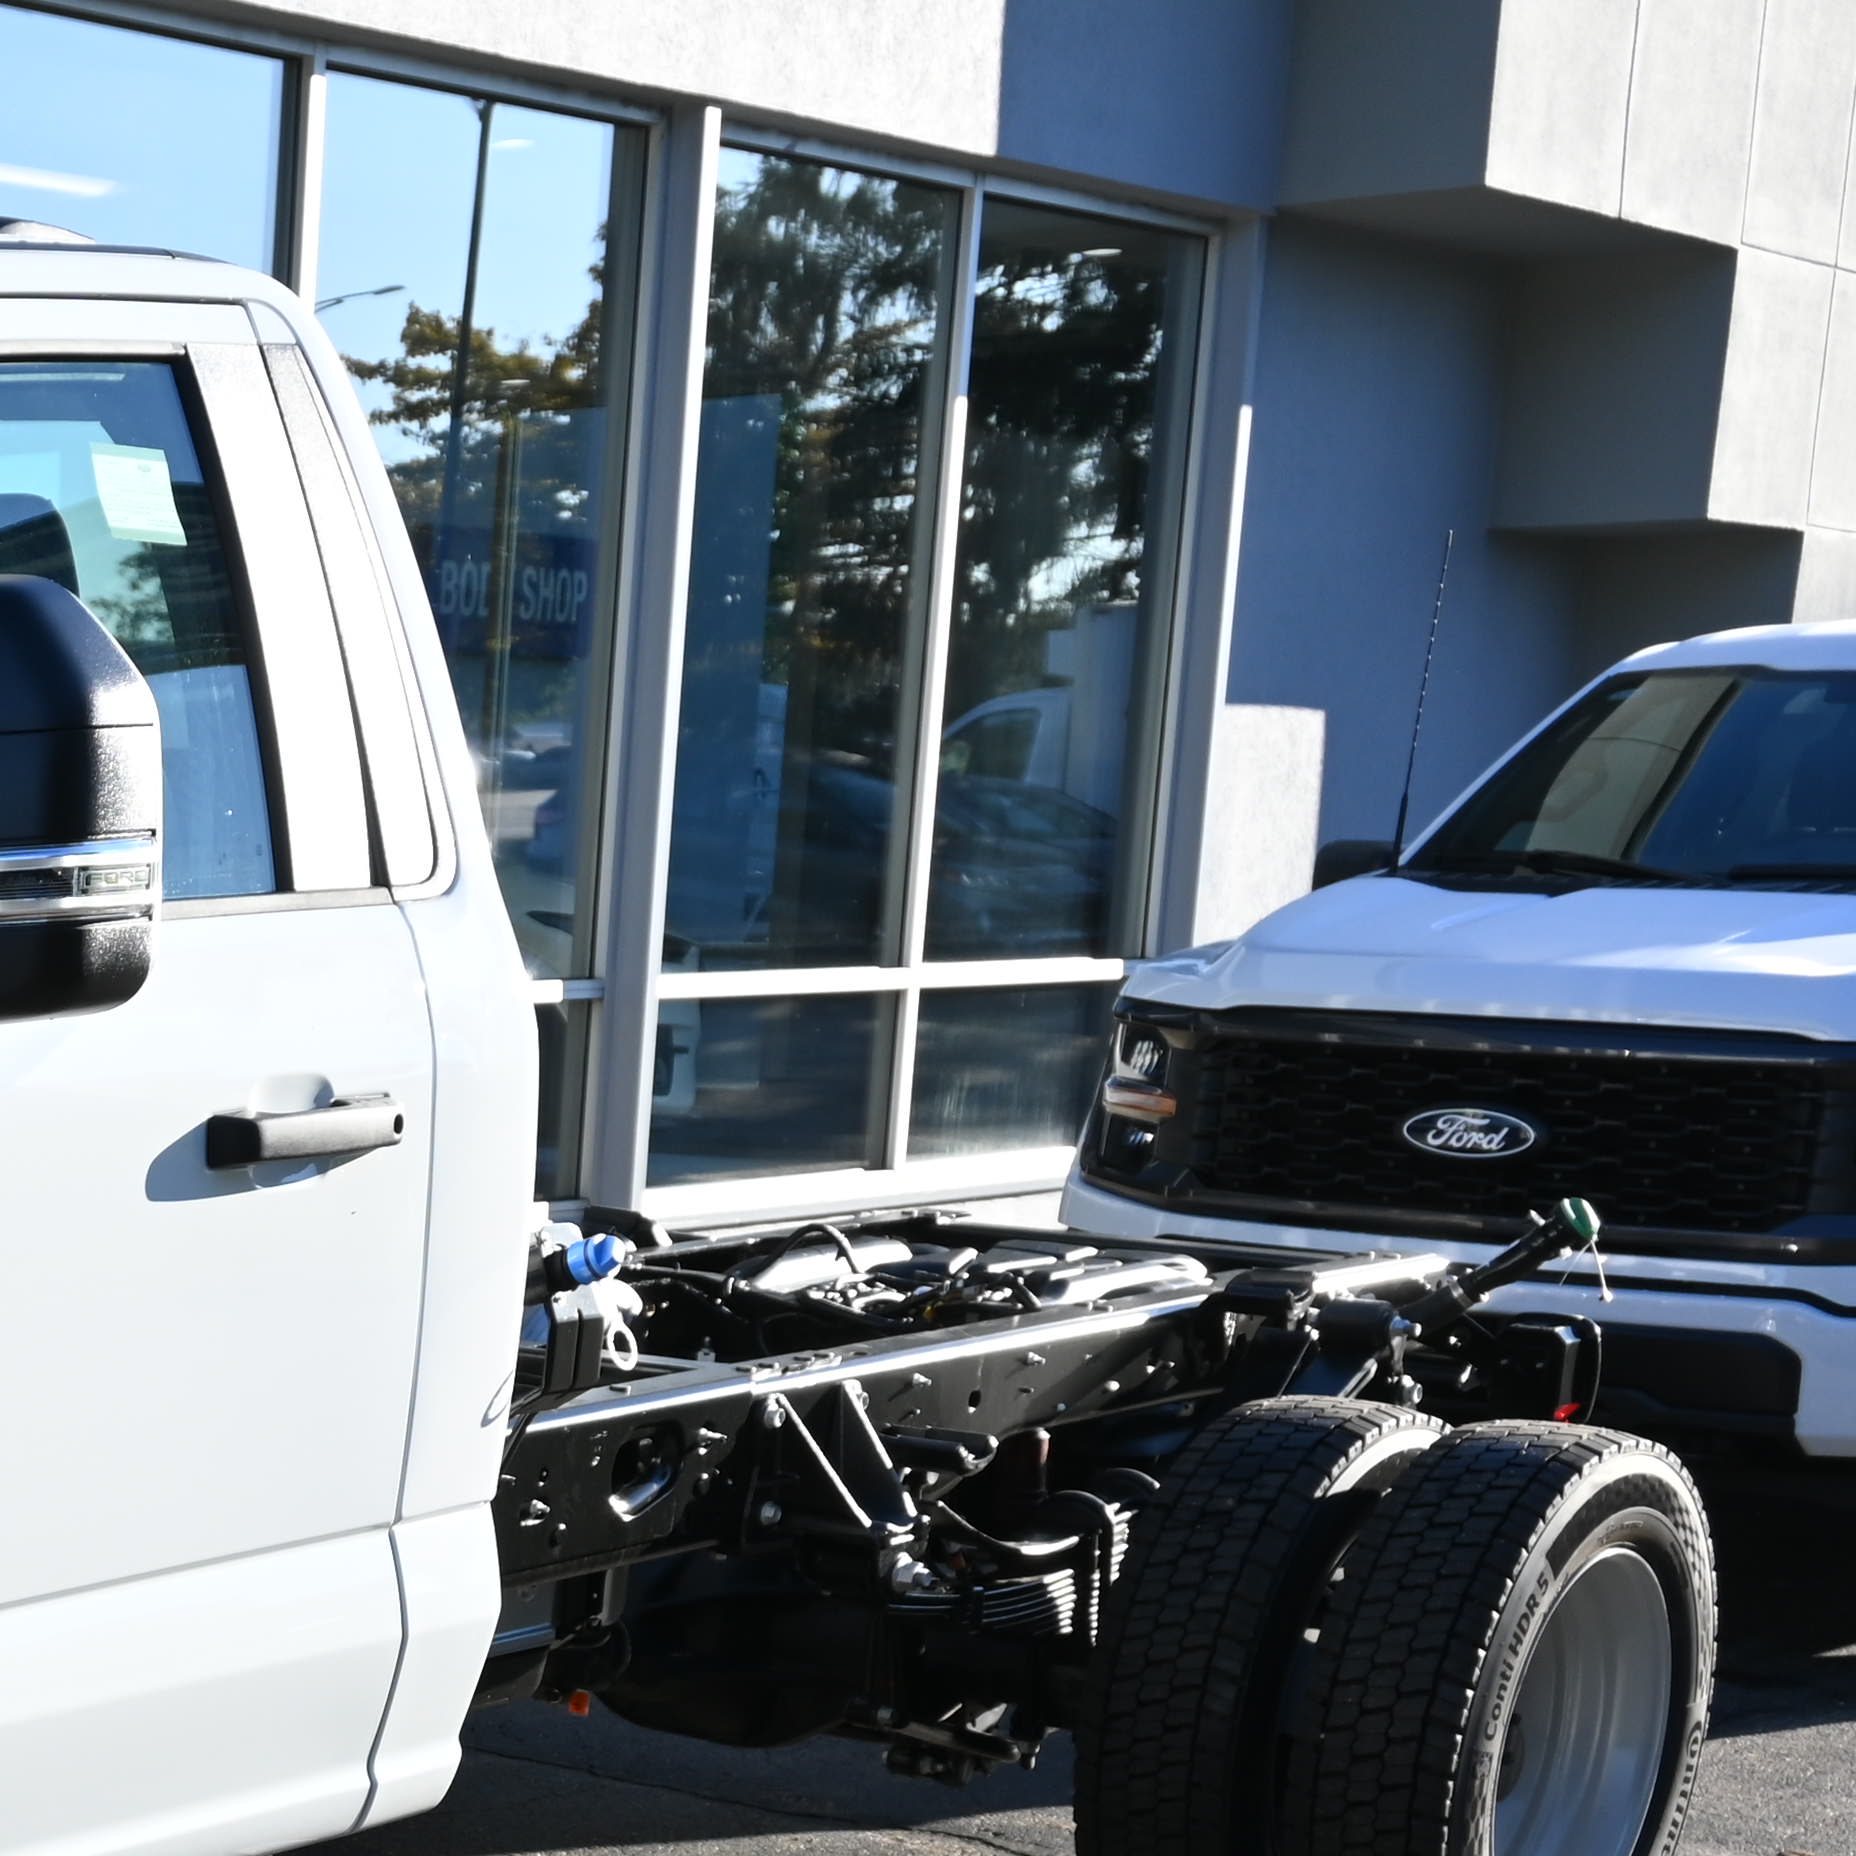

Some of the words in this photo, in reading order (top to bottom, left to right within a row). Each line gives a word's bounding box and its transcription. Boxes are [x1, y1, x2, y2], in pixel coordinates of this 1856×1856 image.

[519, 566, 588, 622] SHOP
[1426, 1114, 1510, 1150] Ford
[1484, 1659, 1515, 1741] Conti
[1508, 1593, 1540, 1659] HDR
[1537, 1571, 1549, 1596] 5
